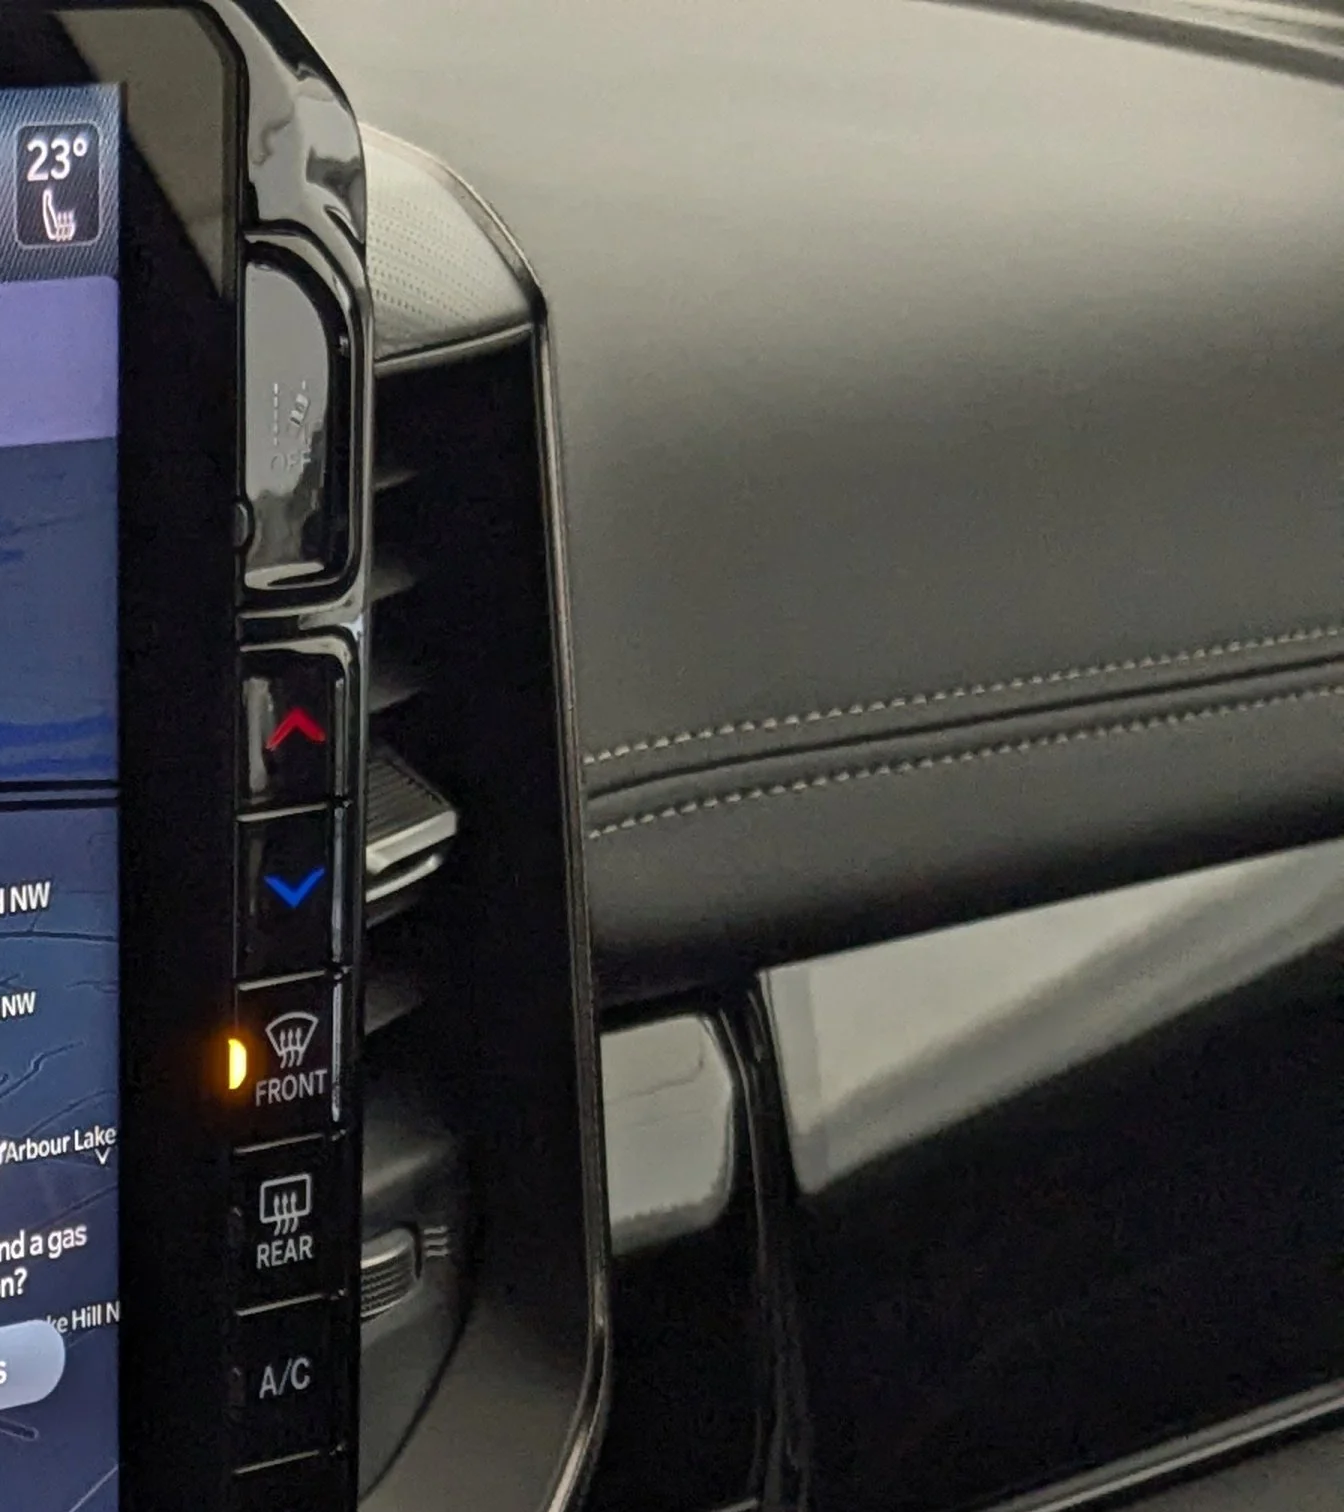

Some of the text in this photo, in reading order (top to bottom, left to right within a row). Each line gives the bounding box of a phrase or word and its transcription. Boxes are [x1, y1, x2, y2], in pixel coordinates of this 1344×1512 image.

[9, 880, 51, 912] NW
[0, 991, 37, 1018] NW
[254, 1068, 326, 1104] FRONT
[5, 1125, 117, 1164] Arbour Lake
[29, 1234, 43, 1256] a
[47, 1224, 88, 1259] gas
[256, 1234, 313, 1268] REAR
[71, 1303, 102, 1330] Hill
[259, 1357, 310, 1397] A/C
